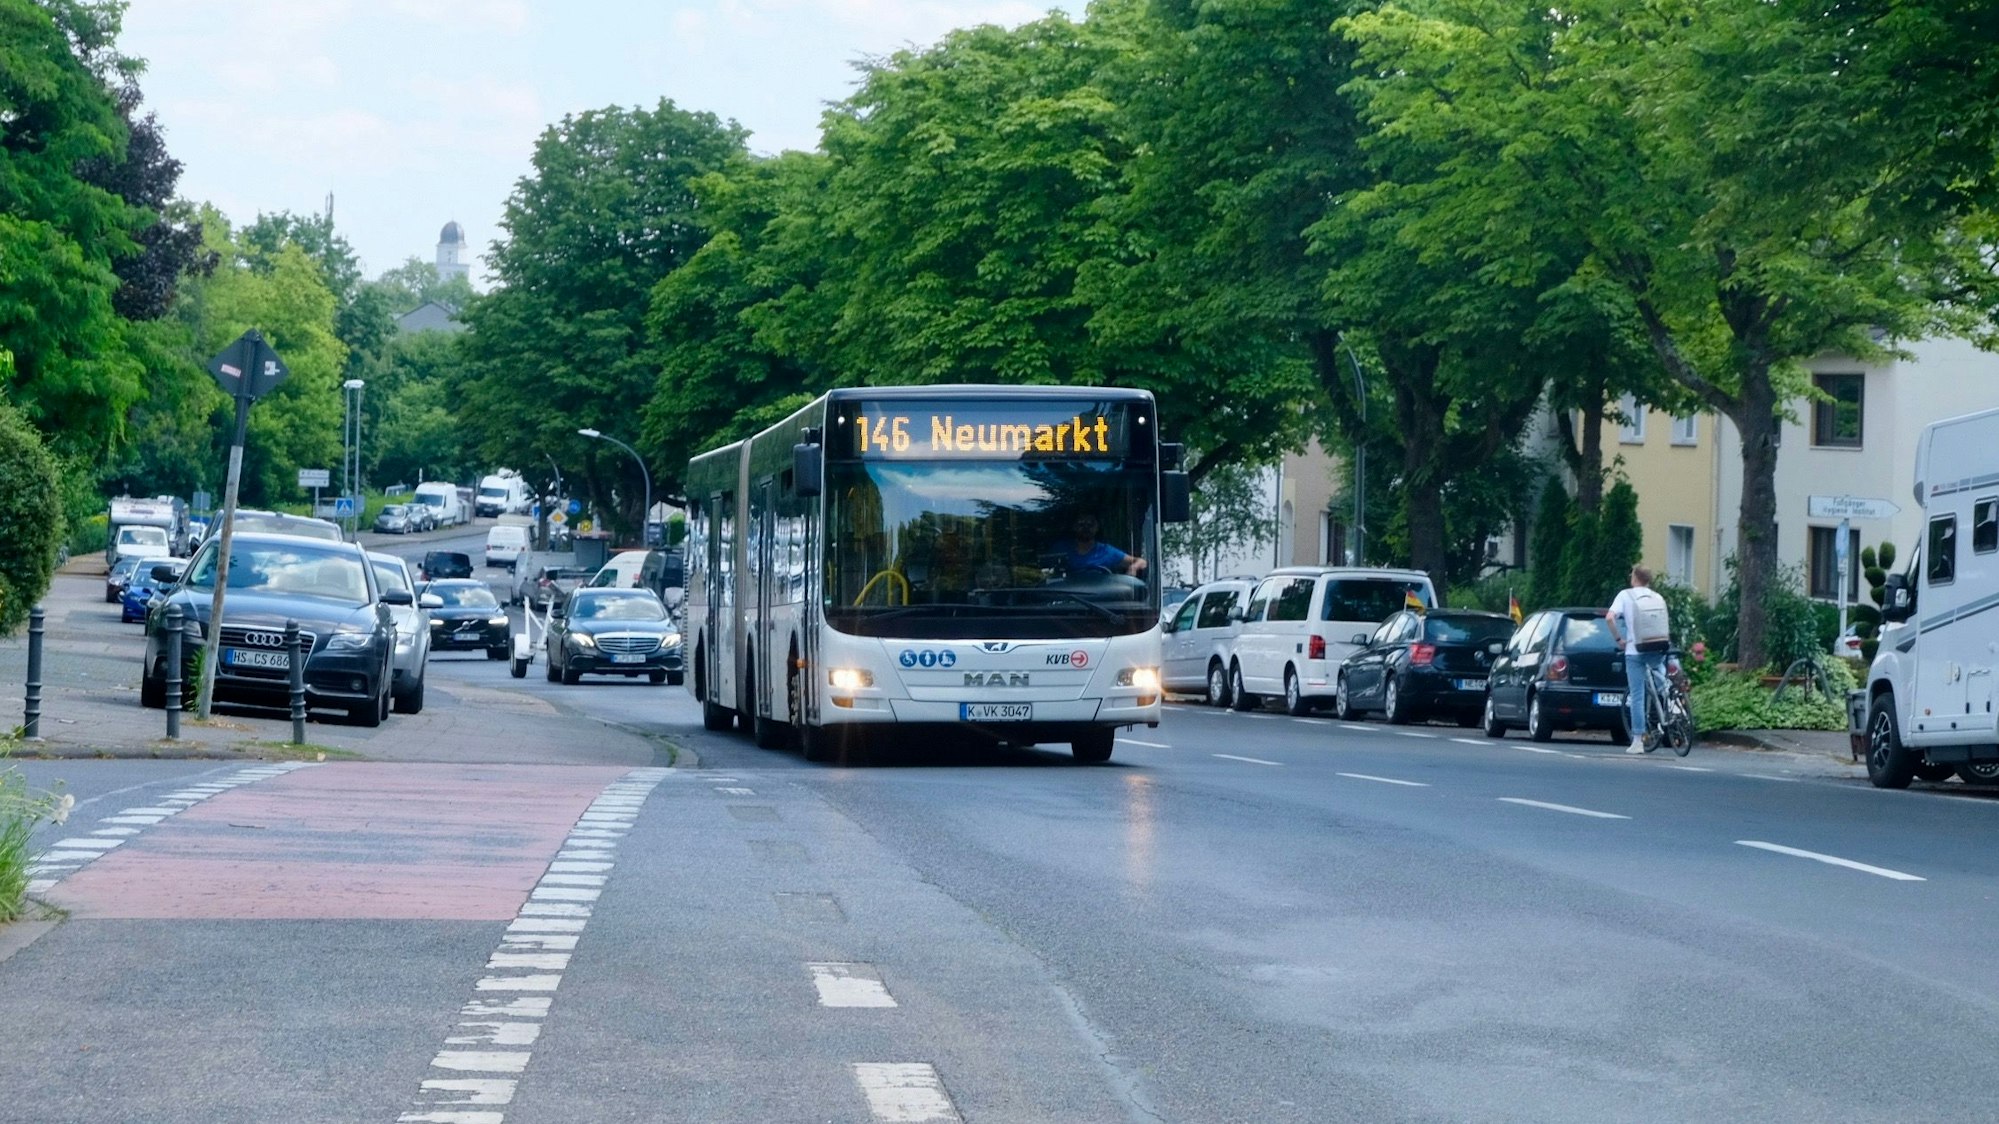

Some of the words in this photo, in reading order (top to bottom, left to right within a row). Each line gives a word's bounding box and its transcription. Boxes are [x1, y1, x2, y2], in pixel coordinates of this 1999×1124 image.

[856, 416, 910, 452] 146
[931, 415, 1109, 452] Neumarkt
[232, 650, 247, 663] HS
[253, 652, 268, 665] CS
[269, 654, 290, 667] 686
[1045, 653, 1070, 665] KVB
[963, 672, 1030, 687] MAN
[967, 705, 975, 717] K
[983, 705, 998, 717] VK
[1000, 705, 1030, 717] 3047
